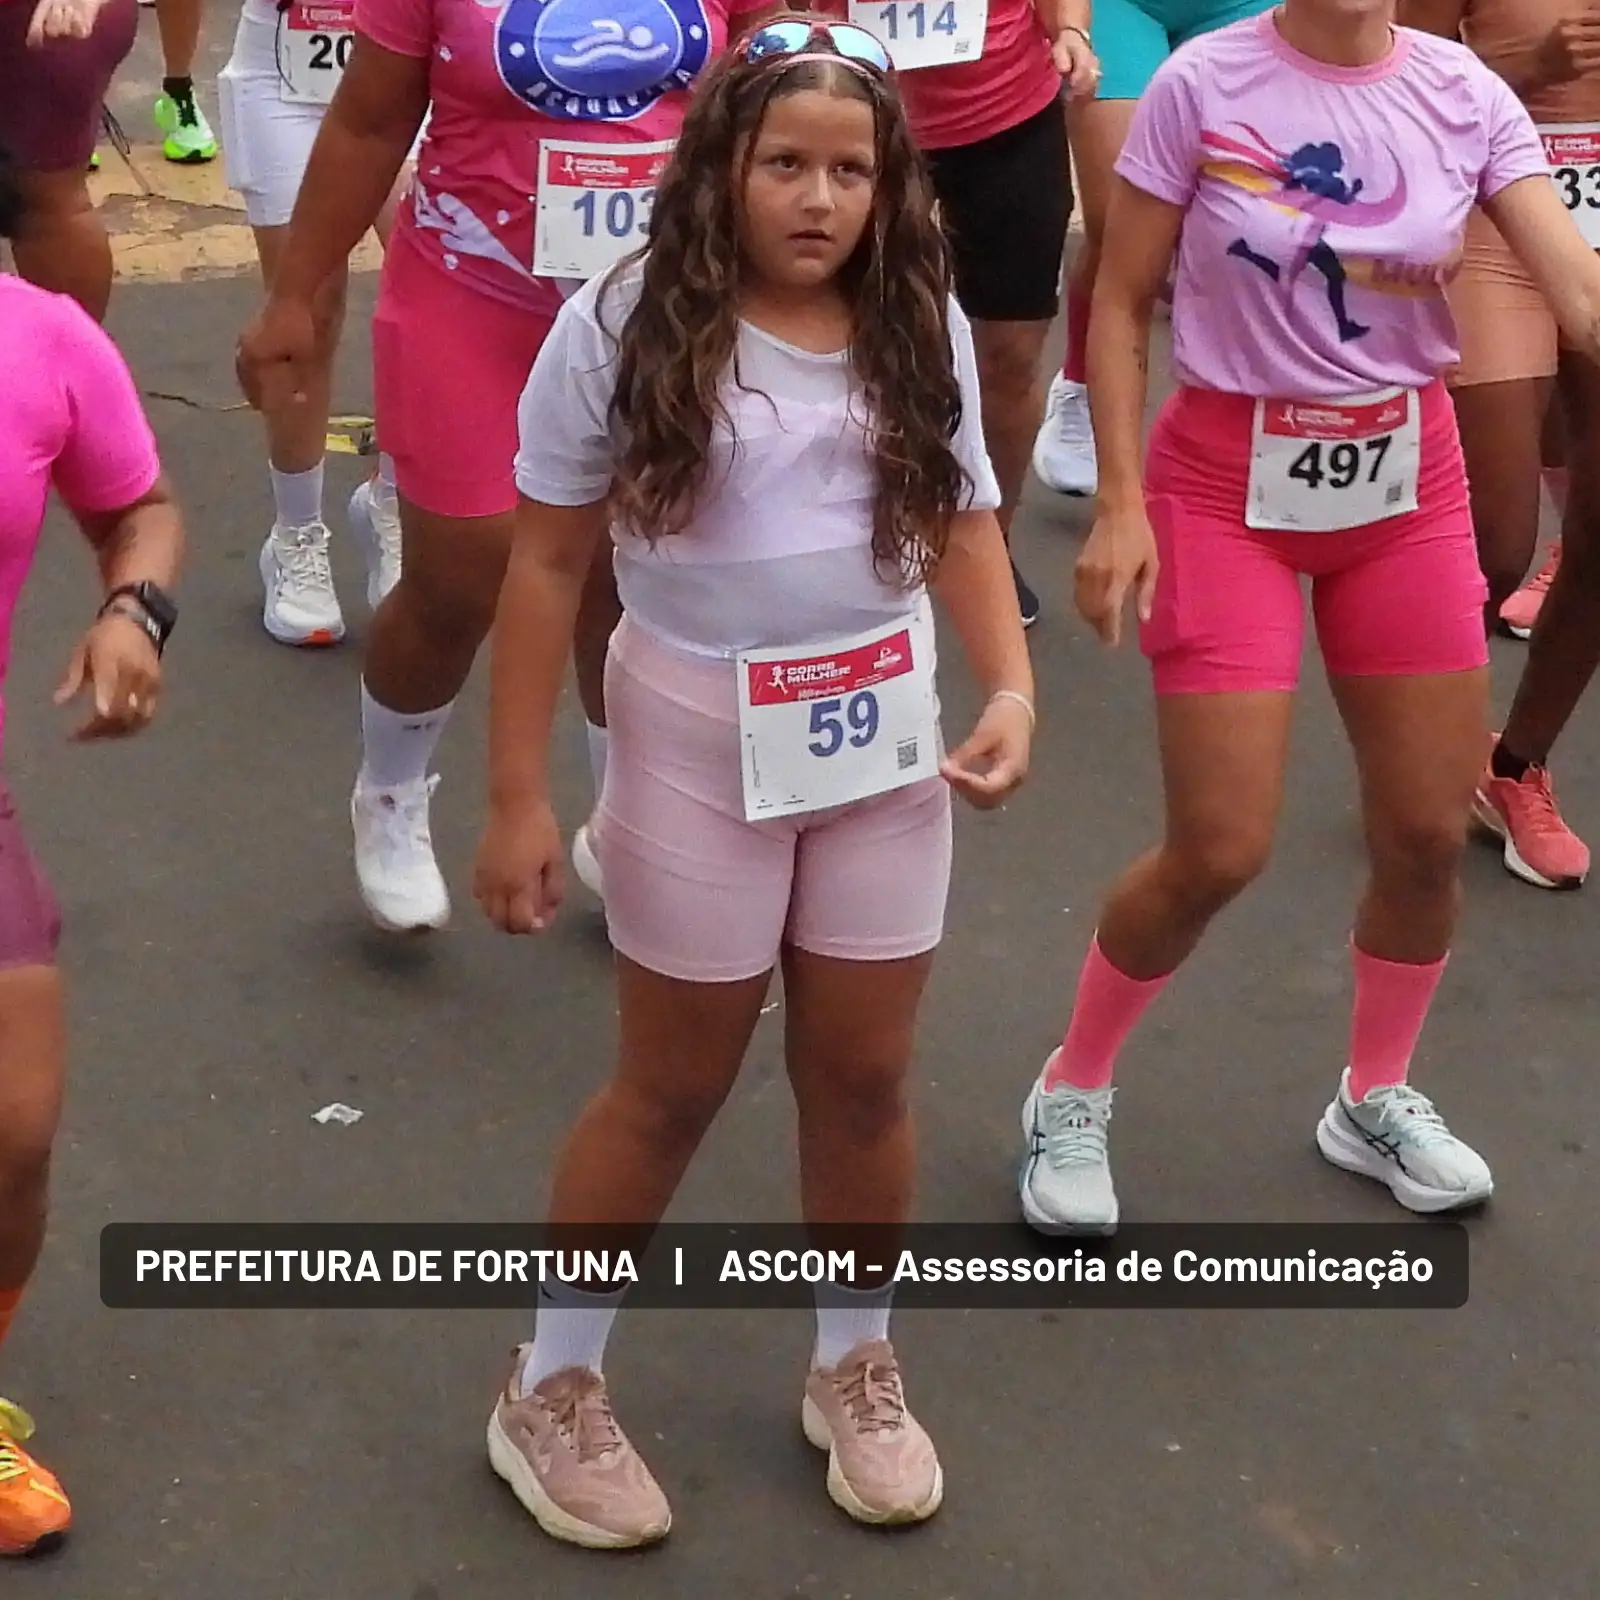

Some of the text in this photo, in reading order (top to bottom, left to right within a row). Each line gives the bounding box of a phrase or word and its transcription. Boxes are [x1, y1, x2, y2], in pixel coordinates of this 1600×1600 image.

[879, 1, 957, 40] 114
[1287, 435, 1393, 489] 497
[808, 690, 879, 758] 59
